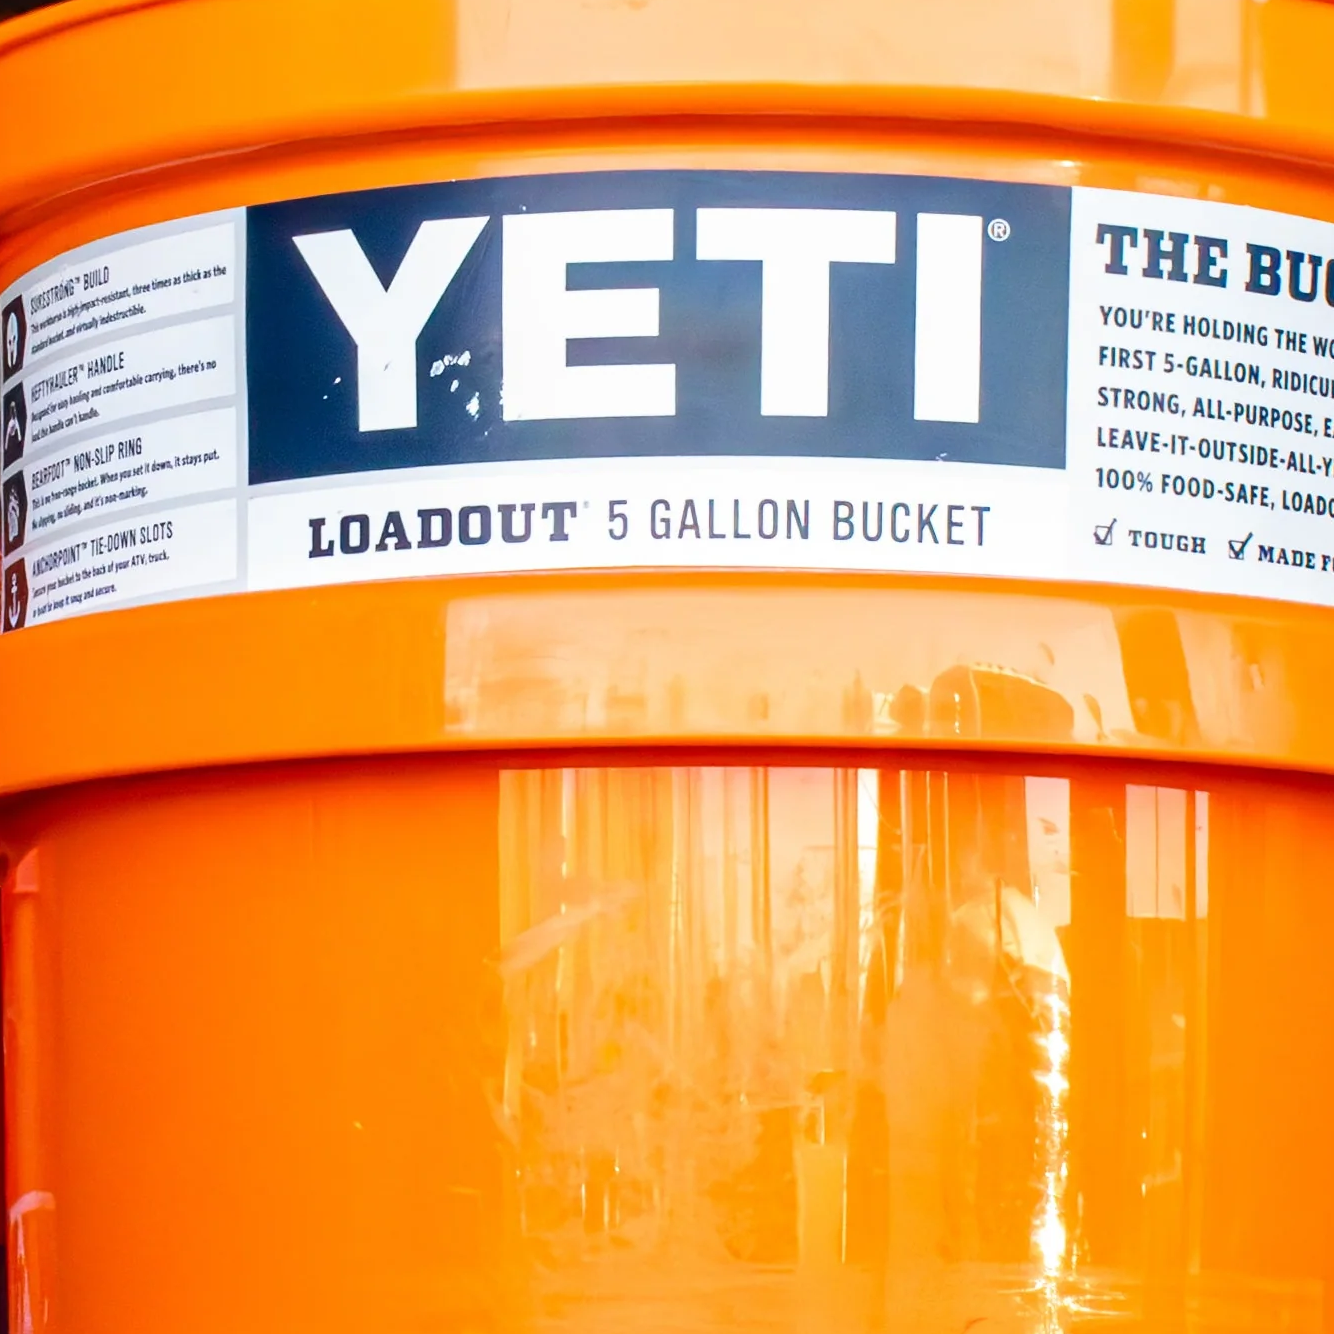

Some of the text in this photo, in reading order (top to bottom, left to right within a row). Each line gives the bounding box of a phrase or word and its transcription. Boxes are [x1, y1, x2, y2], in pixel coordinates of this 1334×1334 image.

[1095, 222, 1228, 288] THE
[83, 266, 110, 291] BUILD
[132, 284, 151, 295] three
[151, 278, 172, 290] times
[173, 275, 182, 286] as
[183, 268, 201, 283] thick
[203, 269, 212, 279] as
[213, 264, 227, 277] the
[1099, 305, 1176, 333] YOU'RE
[1183, 314, 1268, 347] HOLDING
[1274, 328, 1308, 354] THE
[87, 351, 125, 380] HANDLE
[103, 373, 143, 394] comfortable
[144, 367, 177, 383] carrying,
[178, 359, 205, 376] there's
[206, 359, 217, 370] no
[1099, 345, 1157, 371] FIRST
[1163, 353, 1267, 389] 5-GALLON,
[1097, 386, 1187, 418] STRONG,
[1192, 397, 1319, 437] ALL-PURPOSE,
[73, 443, 115, 473] NON-SLIP
[118, 436, 142, 460] RING
[99, 471, 118, 486] When
[119, 469, 132, 483] you
[132, 463, 144, 477] set
[144, 461, 150, 475] it
[151, 459, 174, 473] down,
[174, 455, 181, 467] it
[181, 453, 202, 467] stays
[203, 448, 220, 464] put.
[1095, 467, 1154, 493] 100%
[1160, 473, 1276, 511] FOOD-SAFE,
[90, 529, 136, 557] TIE-DOWN
[140, 520, 173, 545] SLOTS
[607, 499, 629, 541] 5
[649, 499, 811, 543] GALLON
[832, 501, 992, 547] BUCKET
[81, 567, 92, 580] the
[92, 563, 106, 578] back
[107, 560, 114, 573] of
[115, 559, 130, 574] your
[131, 553, 147, 568] ATV,
[148, 549, 170, 563] truck,
[1127, 529, 1207, 555] TOUGH
[1257, 544, 1316, 570] MADE
[95, 583, 117, 597] secure.
